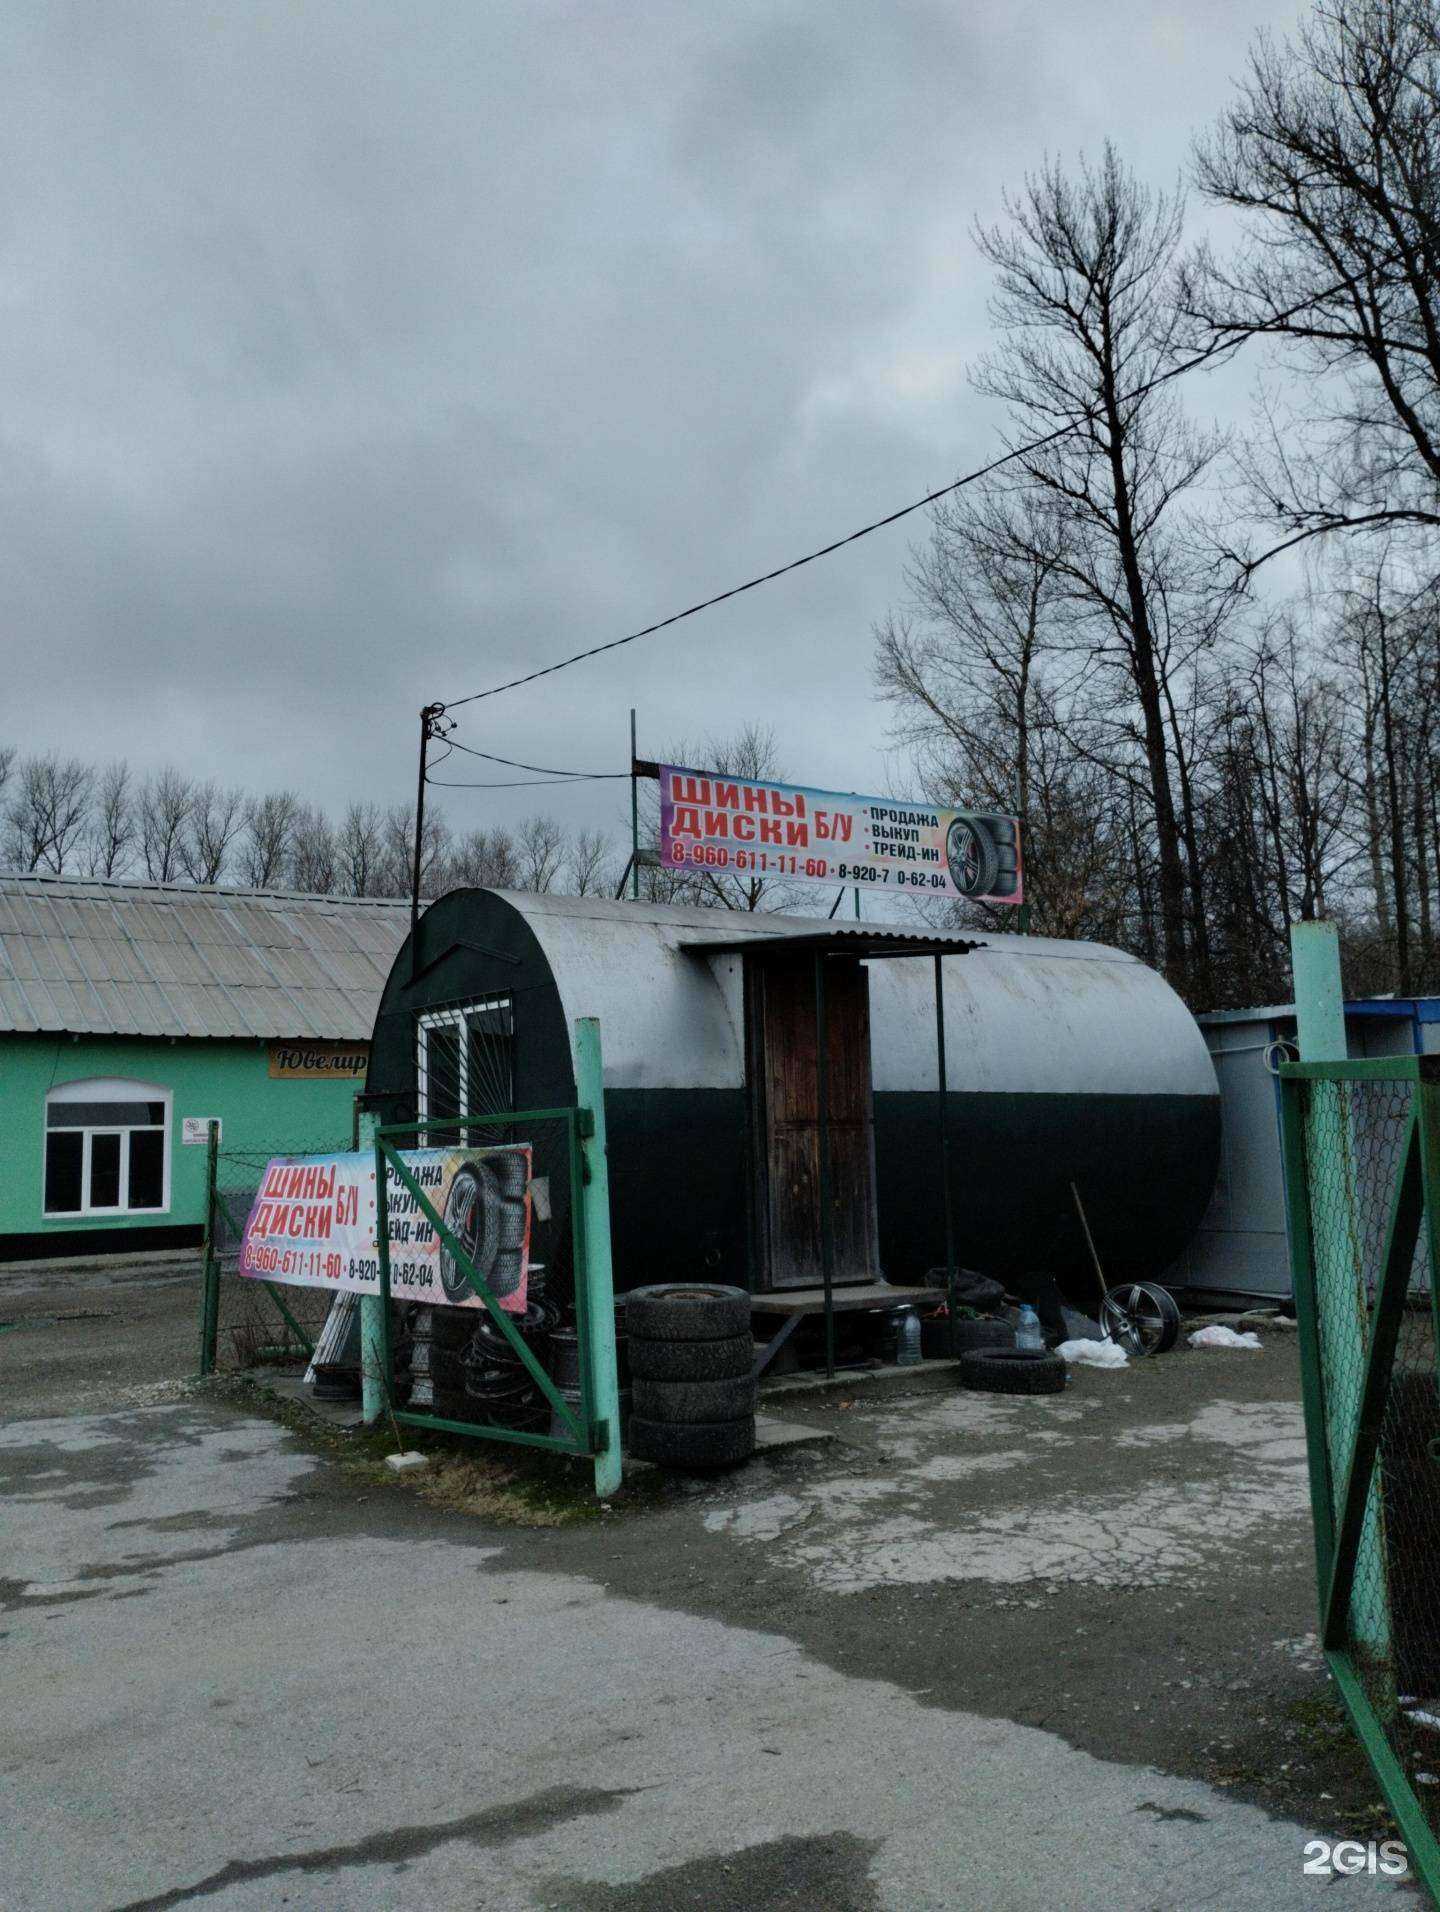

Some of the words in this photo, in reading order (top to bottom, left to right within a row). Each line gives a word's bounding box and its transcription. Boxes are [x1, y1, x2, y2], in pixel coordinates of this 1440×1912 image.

[671, 775, 806, 819] ШИНЫ
[671, 806, 809, 848] ДИСКИ
[814, 810, 853, 843] Б/У
[870, 806, 939, 829] ПРОДАЖА
[871, 823, 920, 843] ВЫКУП
[671, 842, 827, 879] 8-960-611-11-60
[873, 841, 940, 862] ТРЕЙД-ИН
[263, 1164, 337, 1199] ШИНЫ
[249, 1203, 333, 1239] ДИСКИ
[335, 1185, 359, 1227] Б/У
[387, 1219, 434, 1245] ЕЙД-ИН
[245, 1244, 342, 1280] 8-960-611-11-60
